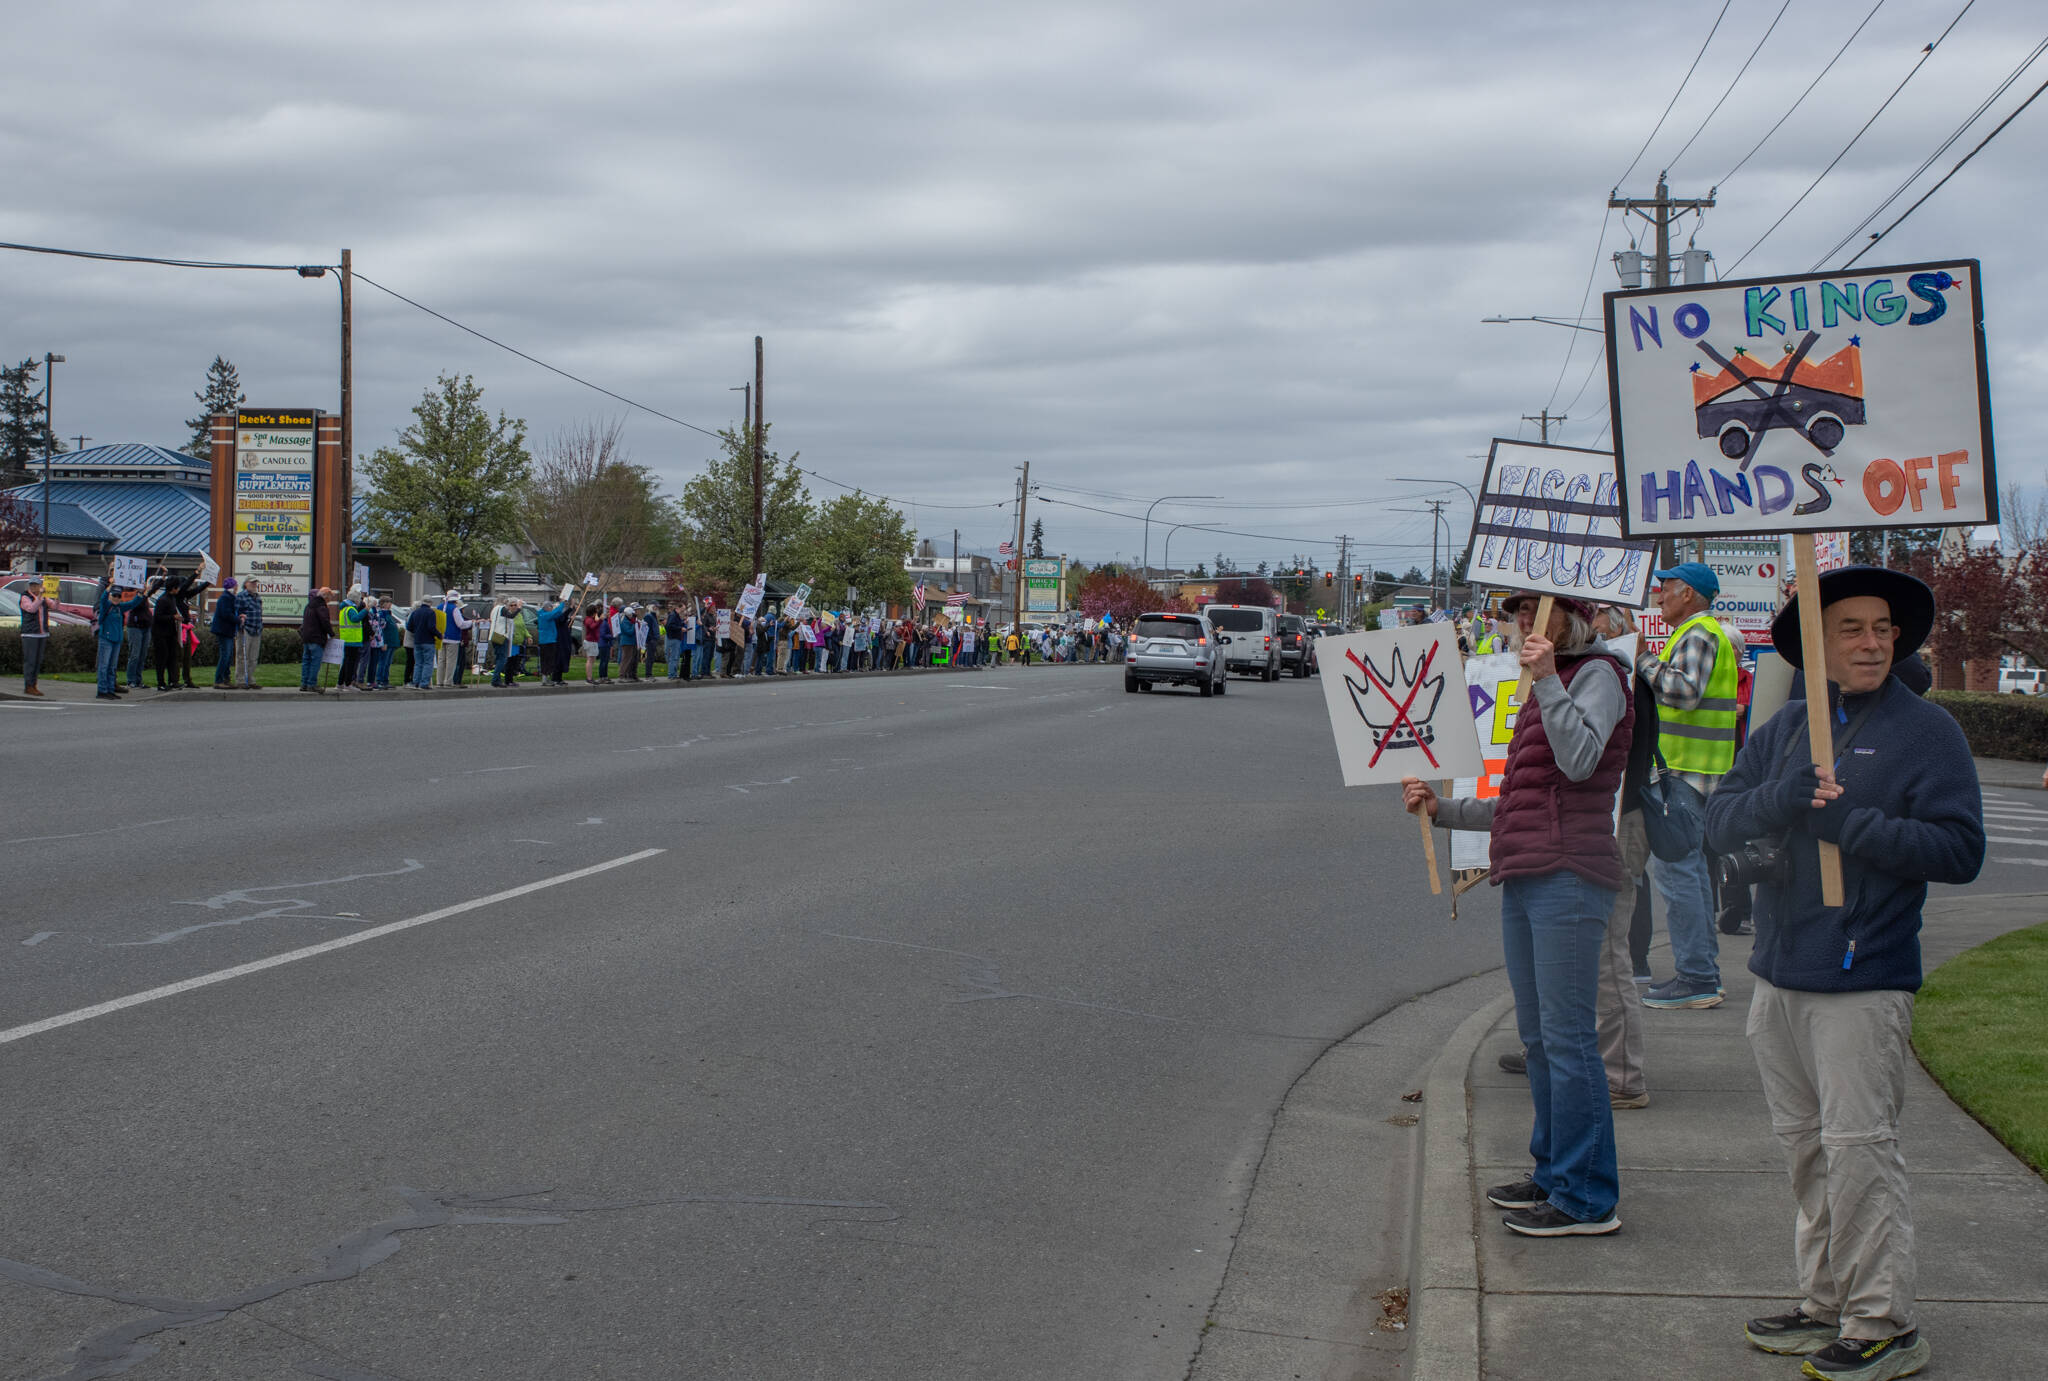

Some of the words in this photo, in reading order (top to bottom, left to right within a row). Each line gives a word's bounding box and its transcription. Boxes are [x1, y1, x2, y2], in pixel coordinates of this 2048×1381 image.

[1629, 303, 1710, 351] NO
[1744, 271, 1961, 337] KINGS
[279, 415, 312, 425] Shoes
[253, 433, 268, 442] Spa
[269, 435, 312, 447] Massage
[262, 457, 291, 465] CANDLE
[293, 457, 307, 465] CO.
[239, 480, 311, 490] SUPPLEMENTS
[1641, 459, 1840, 522] HANDS
[1862, 449, 1969, 516] OFF
[254, 513, 276, 522] Hair
[279, 514, 291, 524] By
[248, 523, 274, 532] Chris
[258, 541, 281, 550] Frozen
[285, 542, 306, 553] Yogurt
[251, 561, 266, 570] Sun
[266, 561, 293, 573] Valley
